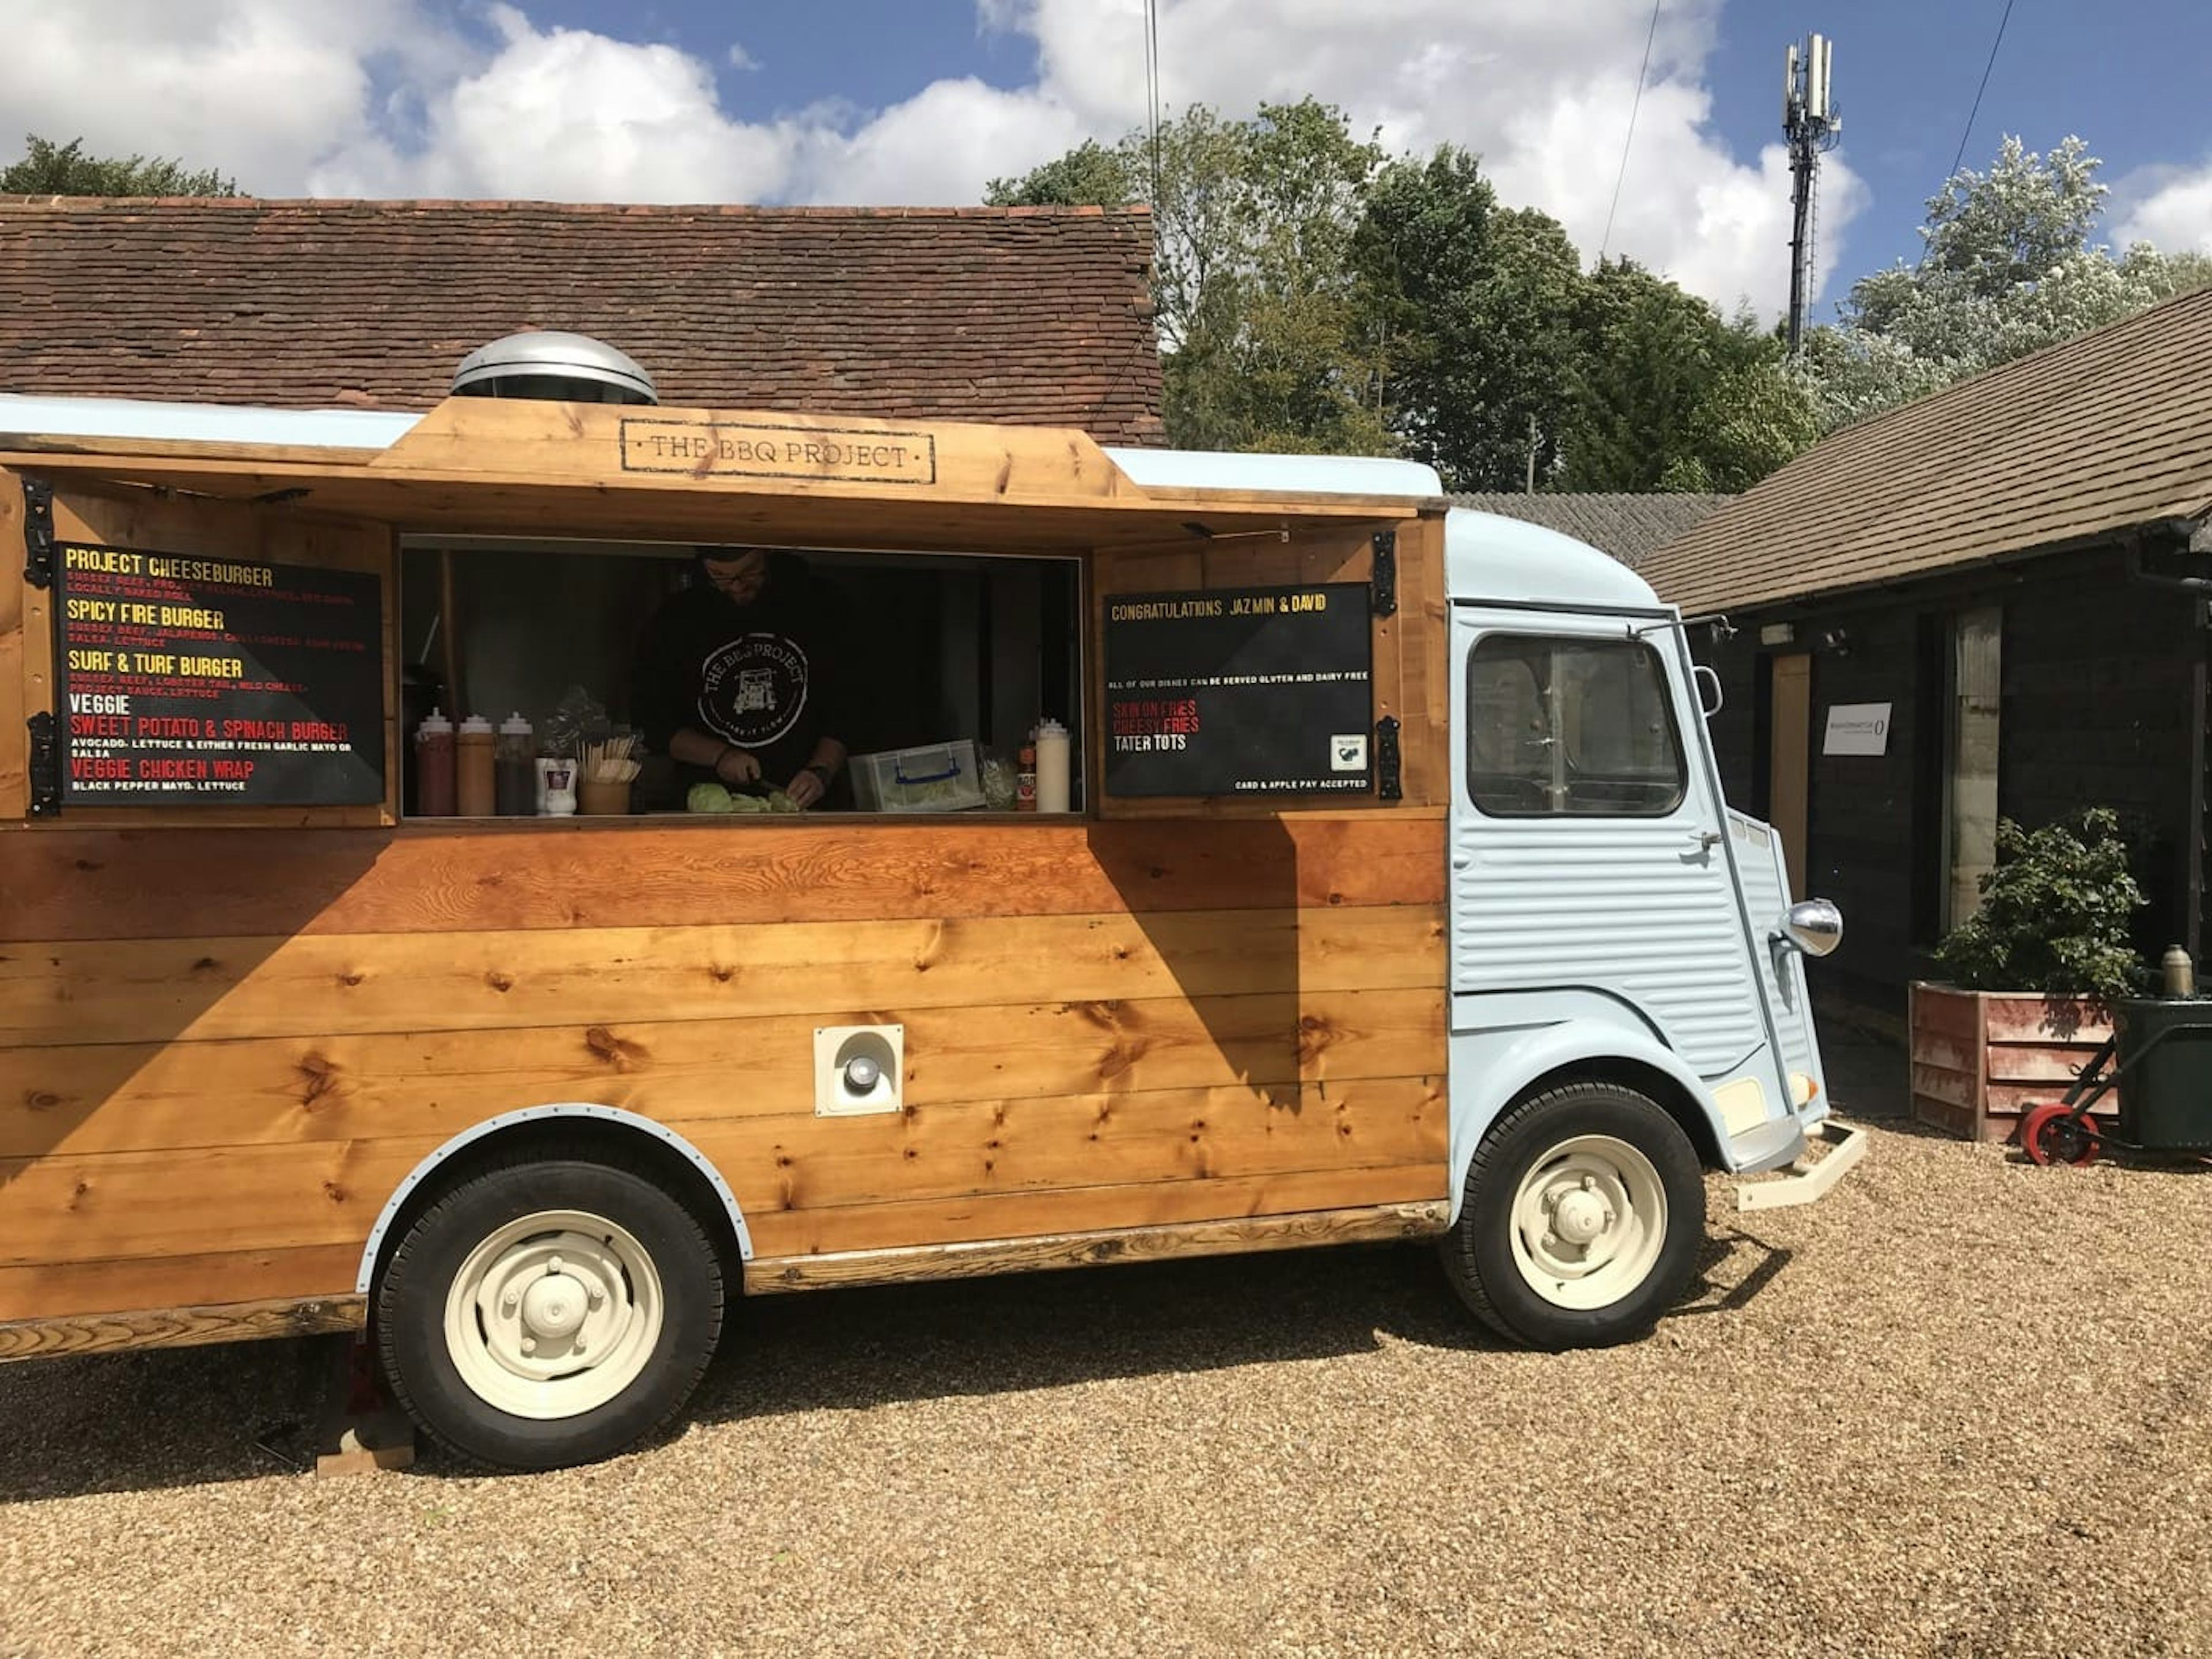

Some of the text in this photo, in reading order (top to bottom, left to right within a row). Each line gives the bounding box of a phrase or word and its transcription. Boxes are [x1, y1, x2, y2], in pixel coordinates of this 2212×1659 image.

[650, 435, 907, 467] THE BBQ PROJECT
[66, 548, 273, 587] PROJECT CHEESEBURGER
[67, 599, 225, 630] SPICY FIRE BURGER
[1111, 593, 1327, 621] CONGRATULATIONS JAZMIN & DAVID
[69, 650, 243, 678] SURF & TURF BURGER
[705, 662, 726, 693] THE
[755, 643, 804, 683] PROJECT
[1126, 680, 1137, 688] OF
[1139, 680, 1156, 688] OUR
[1158, 679, 1188, 687] DISHES
[1191, 678, 1208, 686] CAN
[1210, 677, 1221, 685] BE
[1224, 676, 1257, 685] SERVED
[1260, 675, 1294, 684] GLUTEN
[1296, 673, 1314, 682] AND
[1316, 672, 1342, 682] DAIRY
[1344, 672, 1368, 681] FREE
[69, 693, 130, 715] VEGGIE
[1161, 699, 1196, 716] FRIES
[70, 715, 347, 741] SWEET POTATO & SPINACH BURGER
[1164, 717, 1199, 734] FRIES
[132, 740, 182, 749] LETTUCE
[186, 741, 194, 749] &
[196, 740, 234, 750] EITHER
[237, 741, 271, 751] FRESH
[273, 742, 309, 751] GARLIC
[310, 743, 336, 752] MAYO
[338, 743, 352, 752] OR
[1113, 734, 1187, 751] TATER TOTS
[71, 749, 110, 759] SALSA
[71, 759, 254, 779] VEGGIE CHICKEN WRAP
[72, 781, 110, 791] BLACK
[115, 781, 159, 791] PEPPER
[198, 782, 245, 791] LETTUCE
[1234, 779, 1368, 790] CARD & APPLE PAY ACCEPTED
